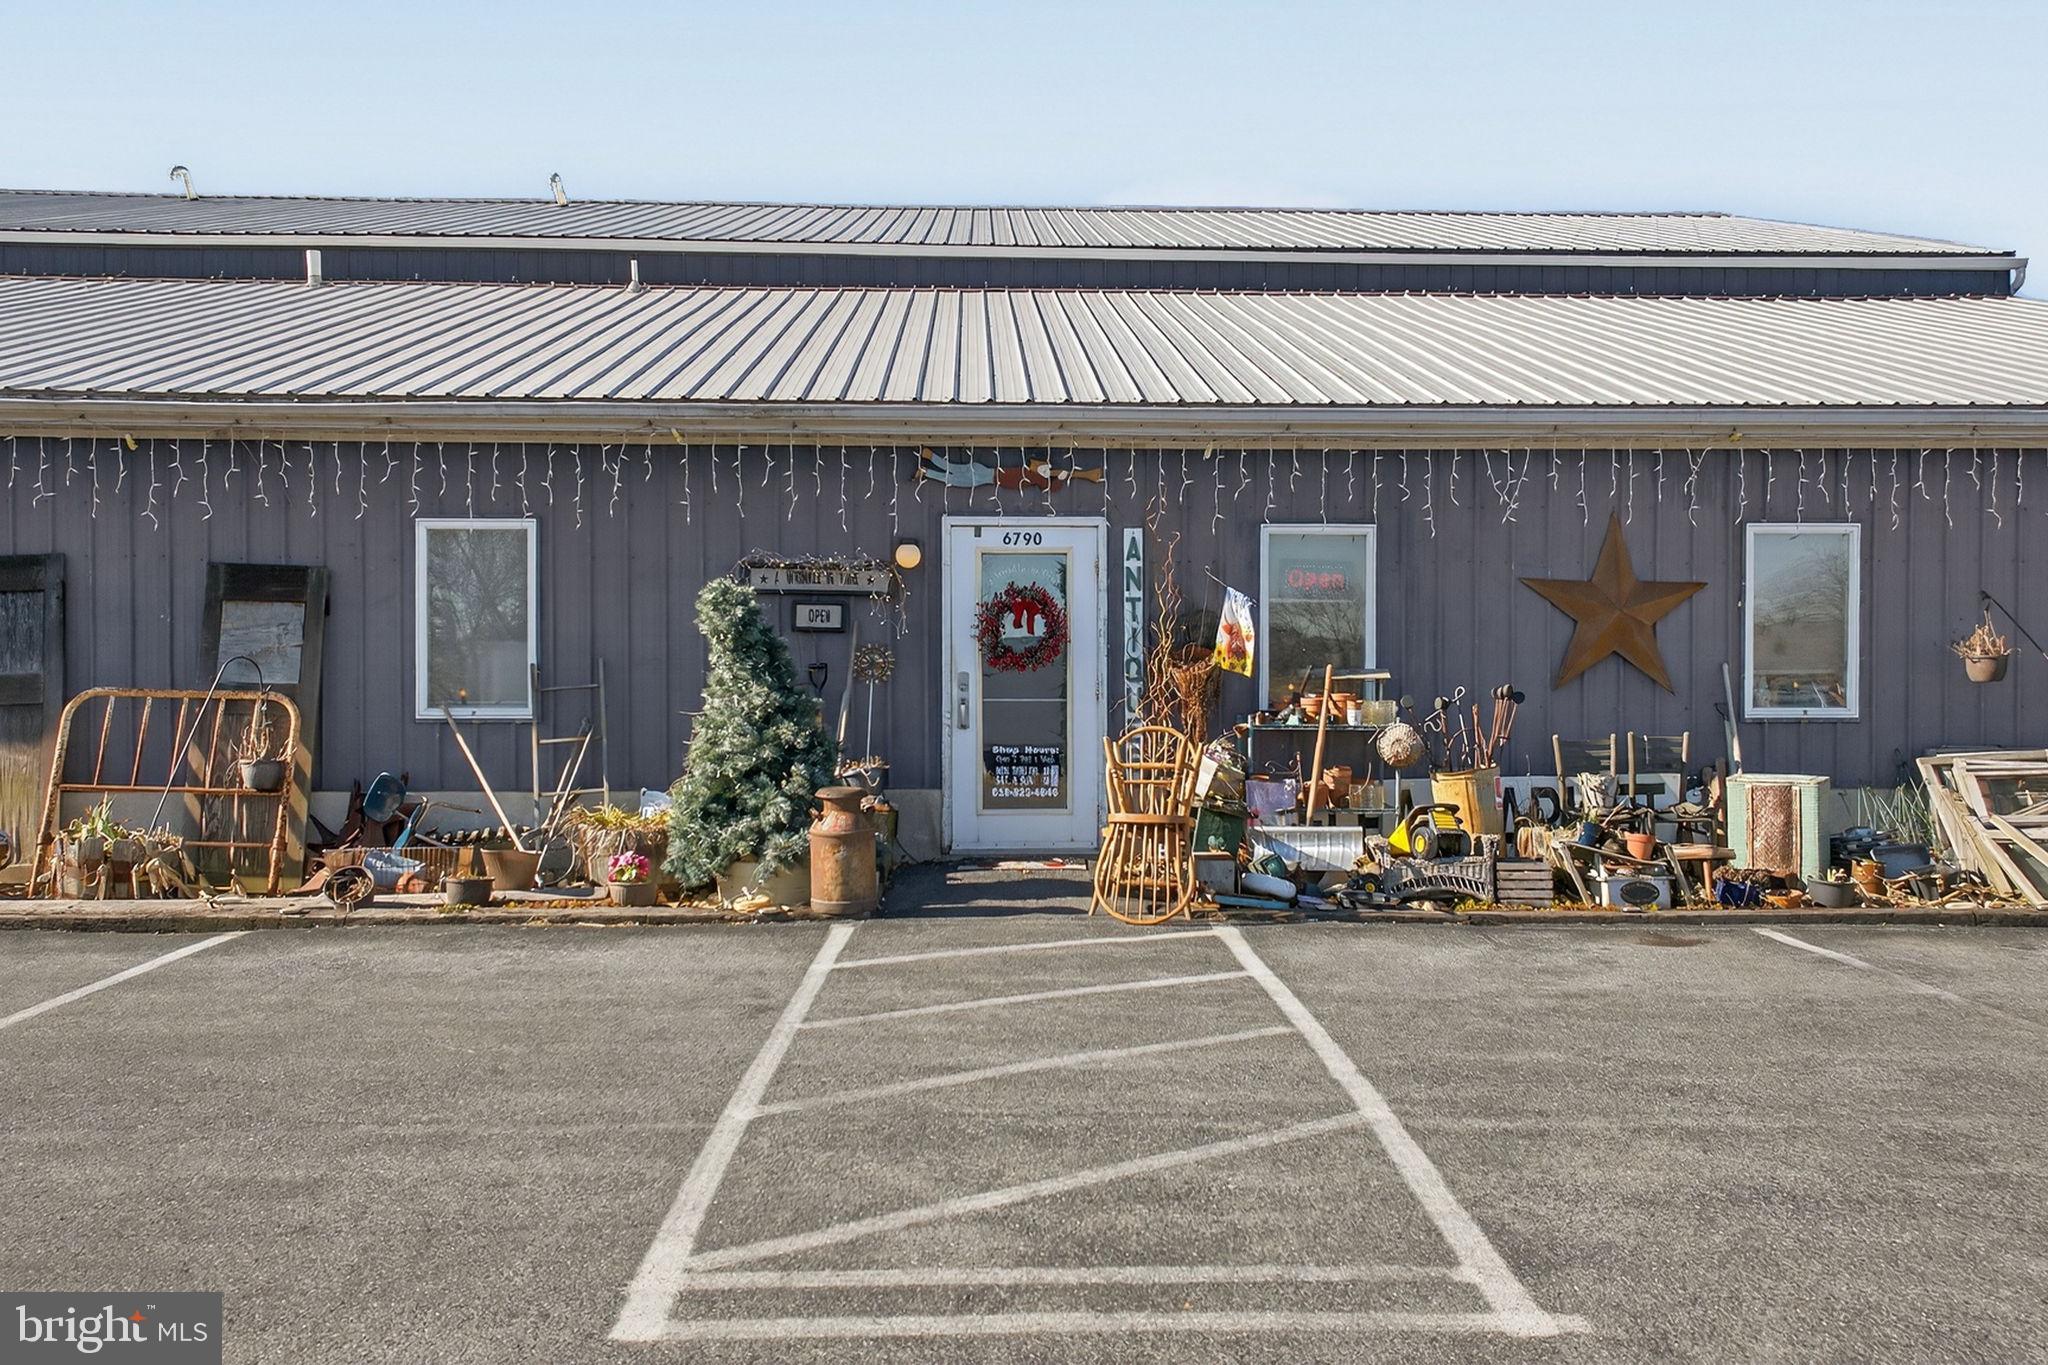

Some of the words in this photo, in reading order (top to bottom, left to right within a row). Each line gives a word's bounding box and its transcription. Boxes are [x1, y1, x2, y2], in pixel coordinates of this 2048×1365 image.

[1003, 532, 1042, 546] 6790
[1287, 567, 1345, 592] Open
[808, 608, 830, 623] OPEN
[992, 746, 1019, 754] Shop
